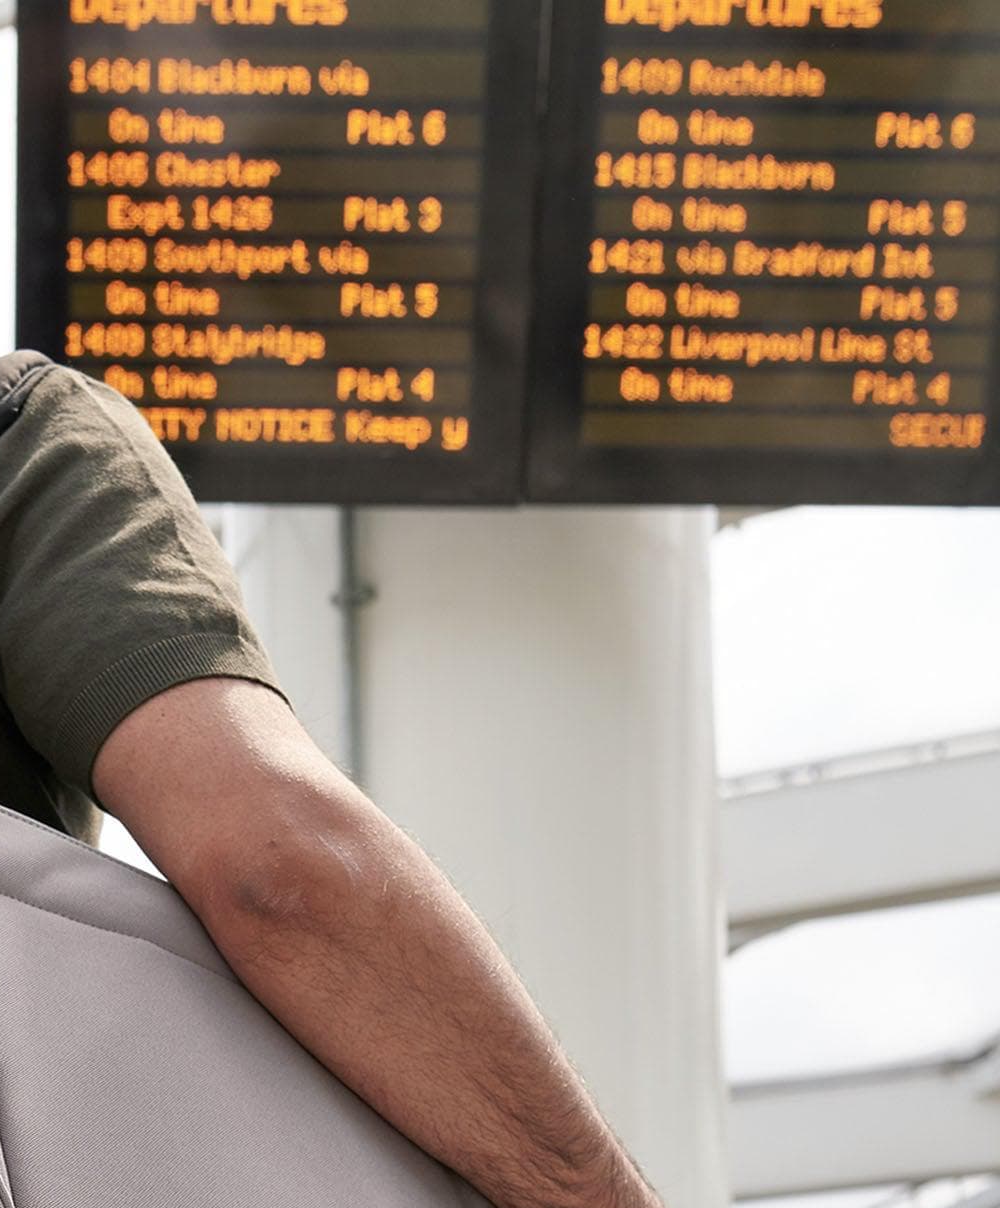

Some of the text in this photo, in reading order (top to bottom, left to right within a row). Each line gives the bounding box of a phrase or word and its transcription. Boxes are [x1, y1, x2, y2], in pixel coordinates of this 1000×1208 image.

[70, 58, 369, 96] 1404 Blackburn via
[689, 59, 825, 96] Rochdale
[109, 108, 445, 145] On time Plat 6
[638, 109, 974, 148] On time Plat 6
[156, 152, 280, 187] Chester
[595, 153, 834, 190] 1415 Blackburn
[108, 195, 184, 235] Expt
[344, 197, 410, 232] Plat
[419, 197, 442, 232] 3
[632, 196, 966, 236] On time Plat 5
[155, 238, 310, 279] Southport
[319, 241, 368, 274] via
[589, 239, 664, 274] 1421
[677, 241, 726, 274] via
[106, 281, 438, 317] On time Plat 5
[626, 282, 958, 320] On time Plat 5
[584, 324, 932, 365] 1422 Liverpool Lime St
[104, 366, 434, 401] On time Plat 4
[620, 367, 950, 405] On time Plat 4
[140, 408, 206, 440] ITY
[216, 408, 334, 442] NOTICE
[345, 411, 432, 449] Keep
